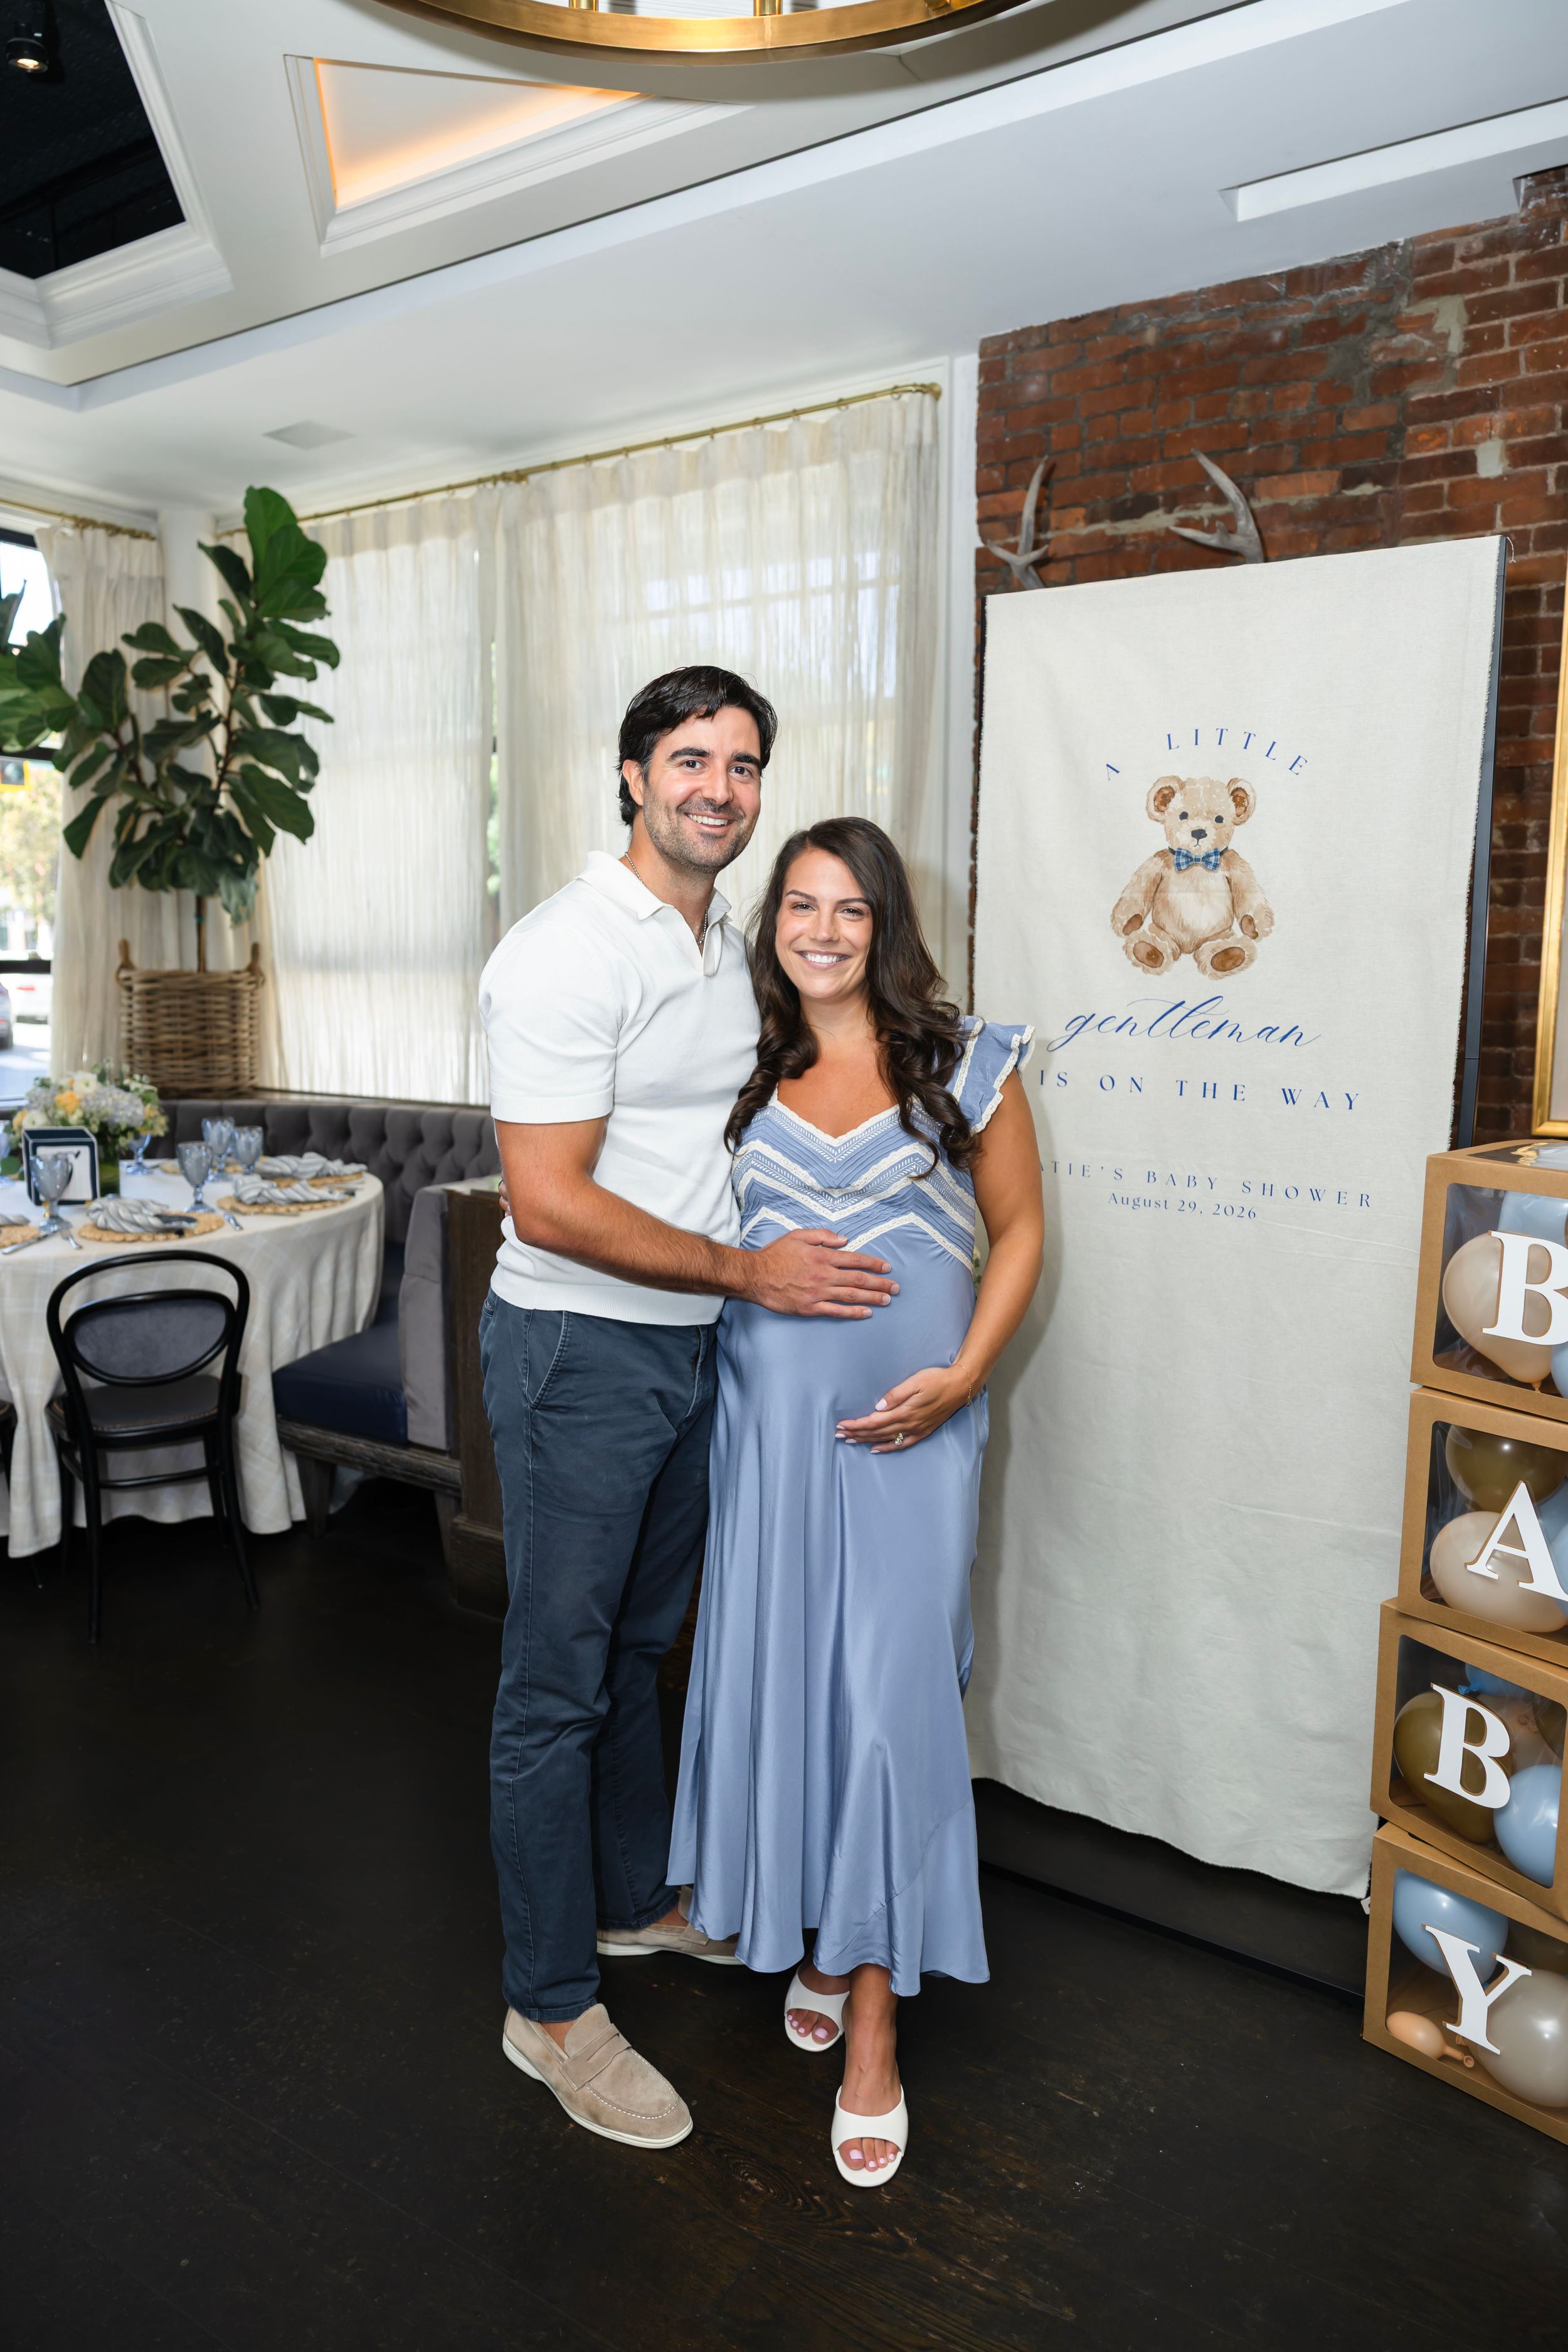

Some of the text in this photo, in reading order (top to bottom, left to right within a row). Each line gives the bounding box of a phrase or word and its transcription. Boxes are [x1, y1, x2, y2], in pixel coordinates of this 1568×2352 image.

[1104, 726, 1308, 781] A LITTLE
[1047, 995, 1322, 1052] gentleman
[1039, 1069, 1360, 1111] IS ON THE WAY
[1108, 1192, 1257, 1221] August 29, 2026
[1147, 1170, 1218, 1190] BABY
[1241, 1180, 1372, 1208] SHOWER
